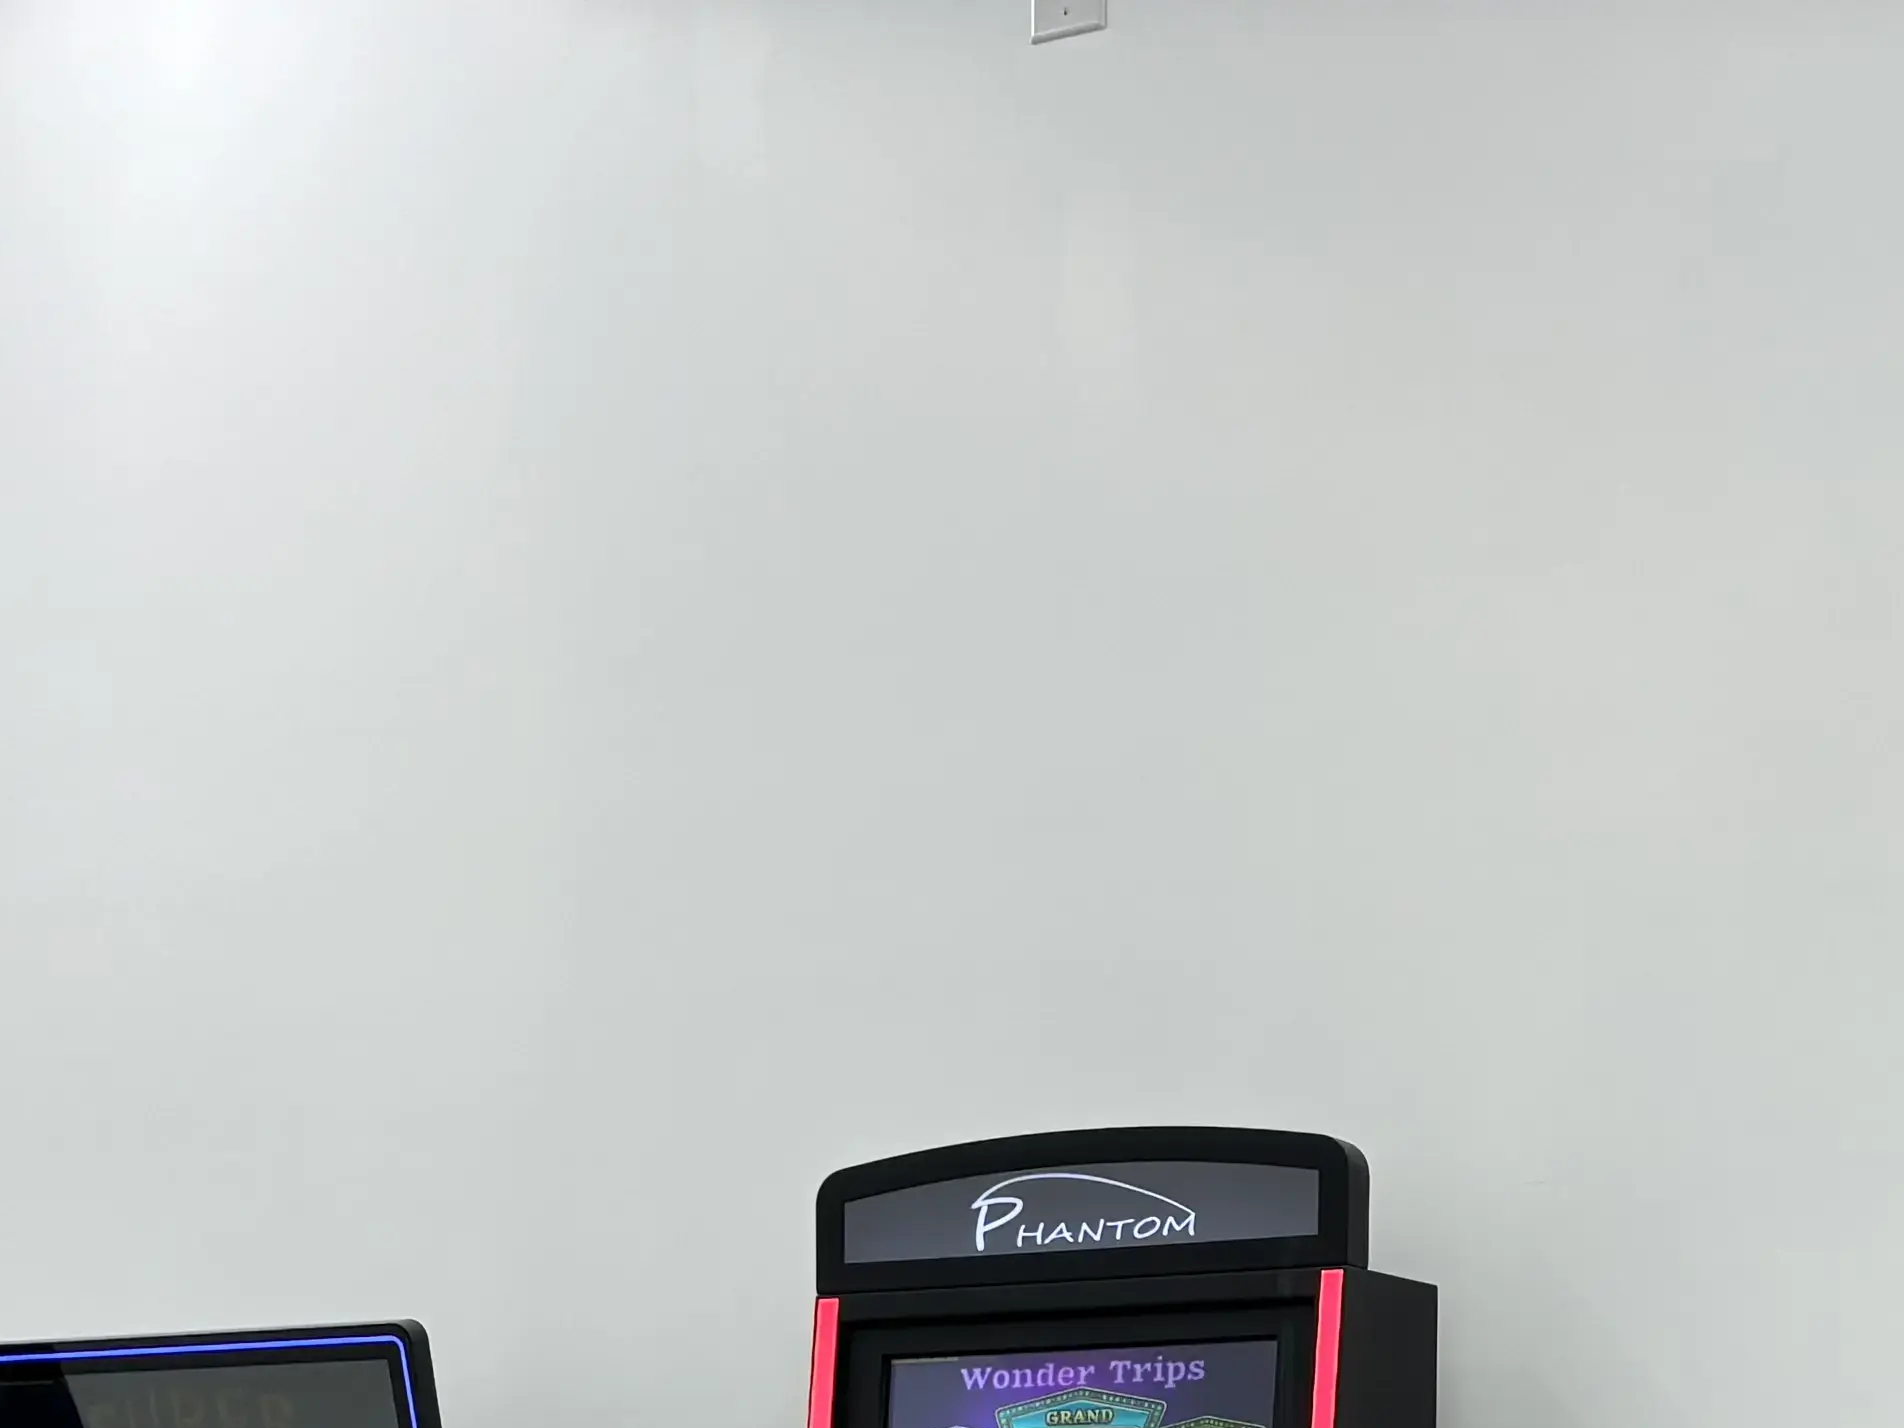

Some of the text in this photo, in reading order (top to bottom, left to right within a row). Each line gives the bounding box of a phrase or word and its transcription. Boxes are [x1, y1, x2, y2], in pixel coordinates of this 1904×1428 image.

[961, 1356, 1205, 1391] Wonder Trips
[1046, 1409, 1113, 1425] GRAND
